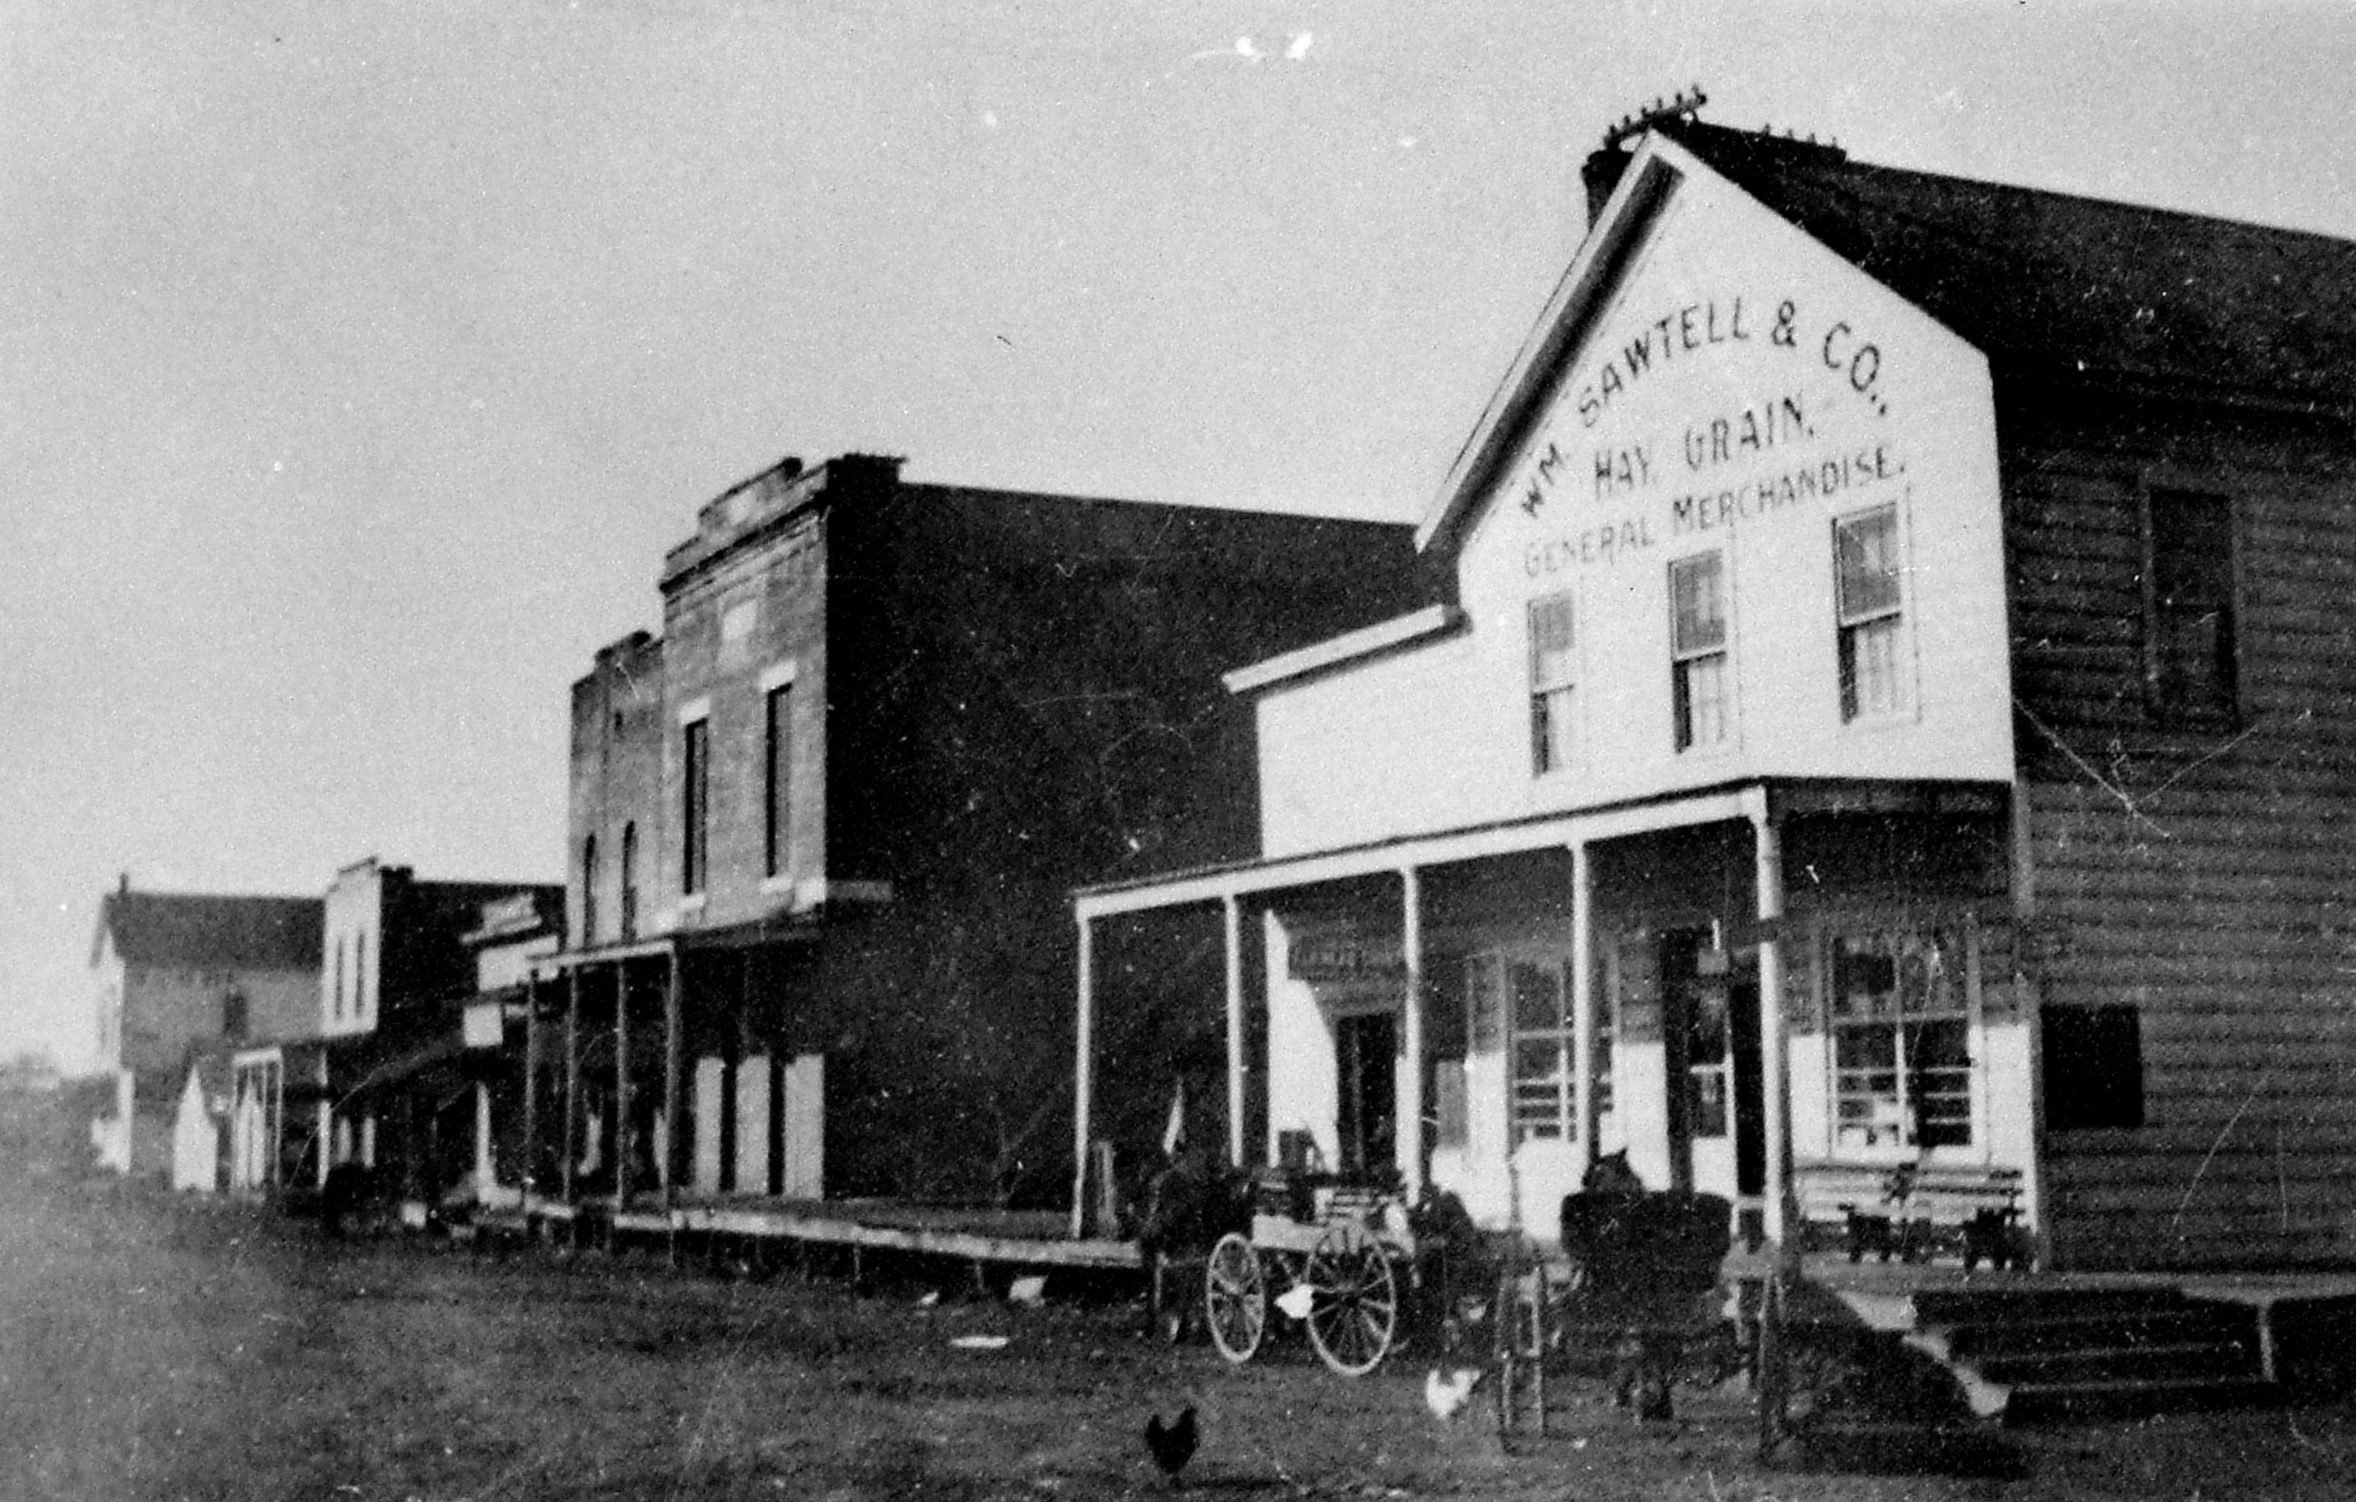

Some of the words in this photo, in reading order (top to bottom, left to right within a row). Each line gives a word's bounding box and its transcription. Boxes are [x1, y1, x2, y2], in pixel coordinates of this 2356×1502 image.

[1579, 296, 1750, 428] SAWTELL
[1772, 300, 1797, 347] &
[1524, 516, 1655, 578] GENERAL
